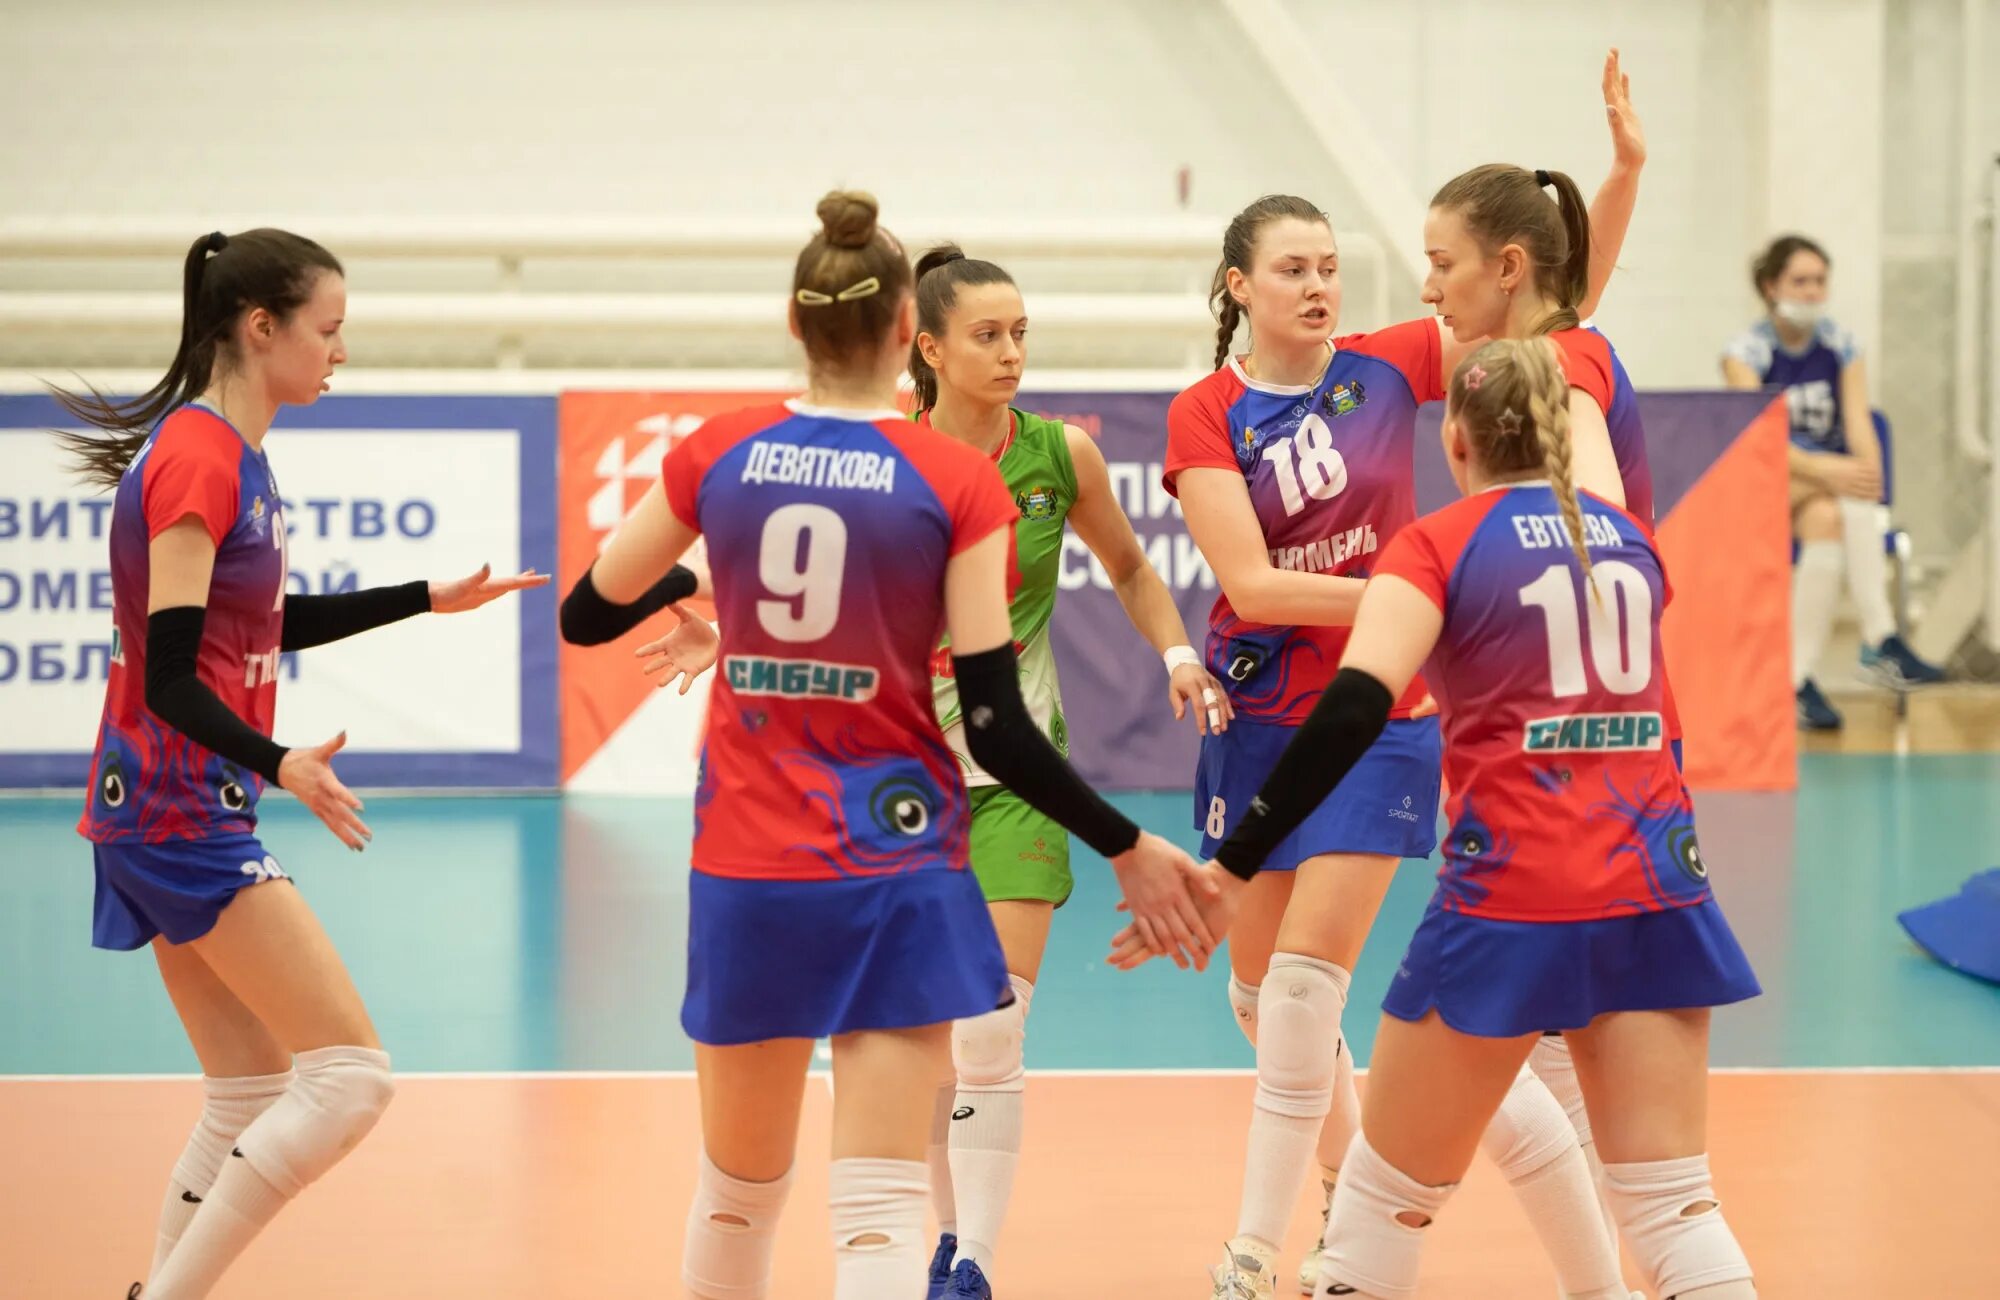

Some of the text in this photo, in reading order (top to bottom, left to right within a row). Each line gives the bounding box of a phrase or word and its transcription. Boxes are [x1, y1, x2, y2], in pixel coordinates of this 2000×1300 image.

[741, 441, 896, 493] ДЕВЯТКОВА
[1262, 413, 1348, 517] 18
[757, 503, 848, 643] 9
[1518, 560, 1652, 698] 10
[728, 659, 876, 700] СИБУР
[1527, 715, 1662, 750] СИБУР
